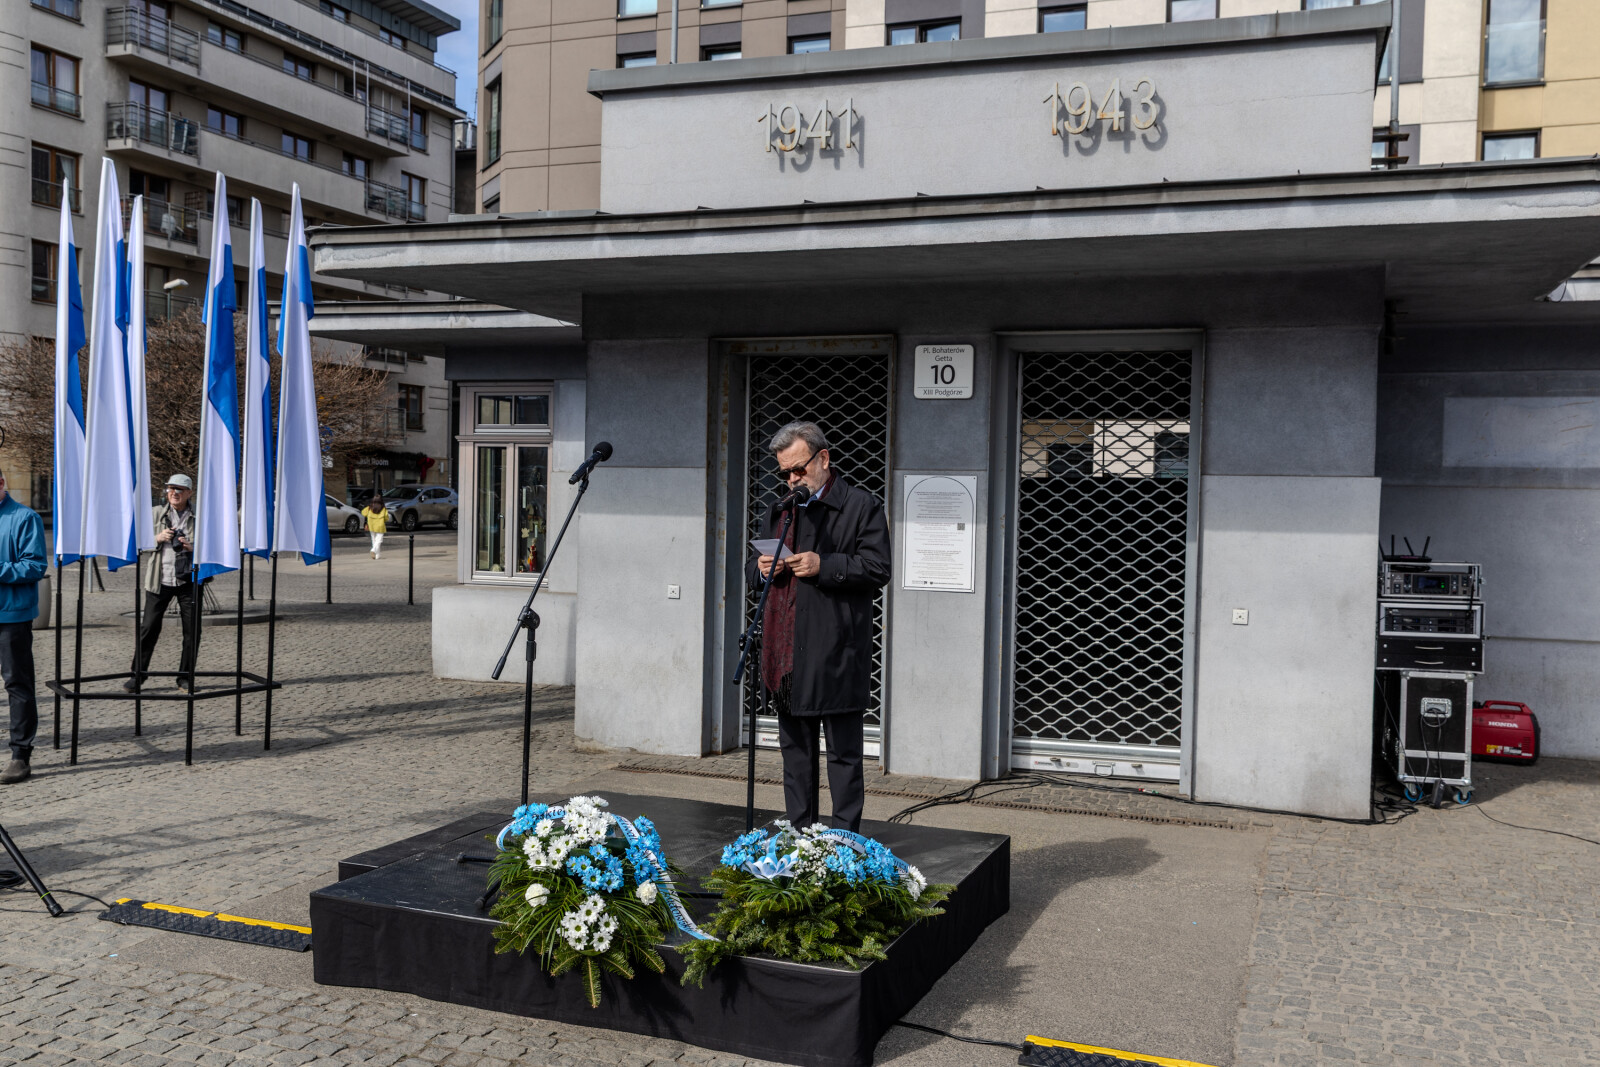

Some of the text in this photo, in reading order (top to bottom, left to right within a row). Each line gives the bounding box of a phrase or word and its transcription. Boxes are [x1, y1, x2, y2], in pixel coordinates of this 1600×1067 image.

[1043, 76, 1158, 136] 1943
[758, 98, 853, 152] 1941
[931, 364, 956, 384] 10
[935, 389, 963, 397] Podgórze
[371, 457, 389, 466] Room
